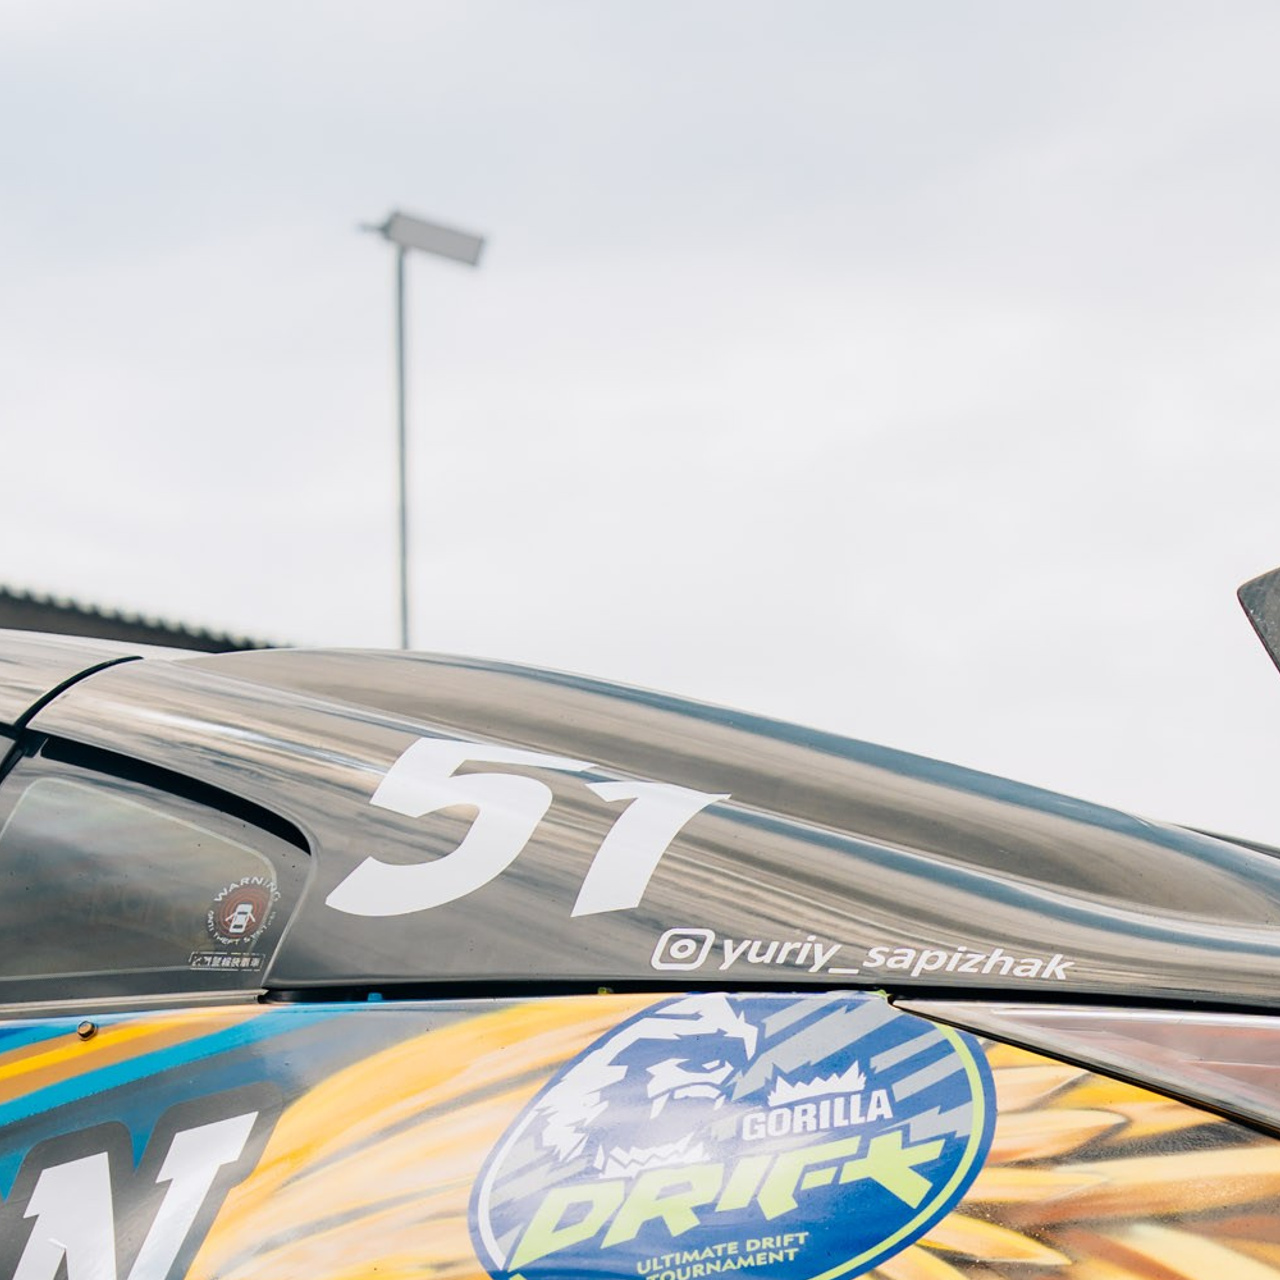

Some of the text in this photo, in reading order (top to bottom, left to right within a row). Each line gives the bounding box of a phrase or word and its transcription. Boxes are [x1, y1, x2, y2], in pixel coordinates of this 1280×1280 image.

[214, 876, 281, 902] WARNING
[719, 935, 1076, 981] yuriy_sapizhak
[742, 1089, 894, 1141] GORILLA
[636, 1231, 810, 1275] ULTIMATE DRIFT
